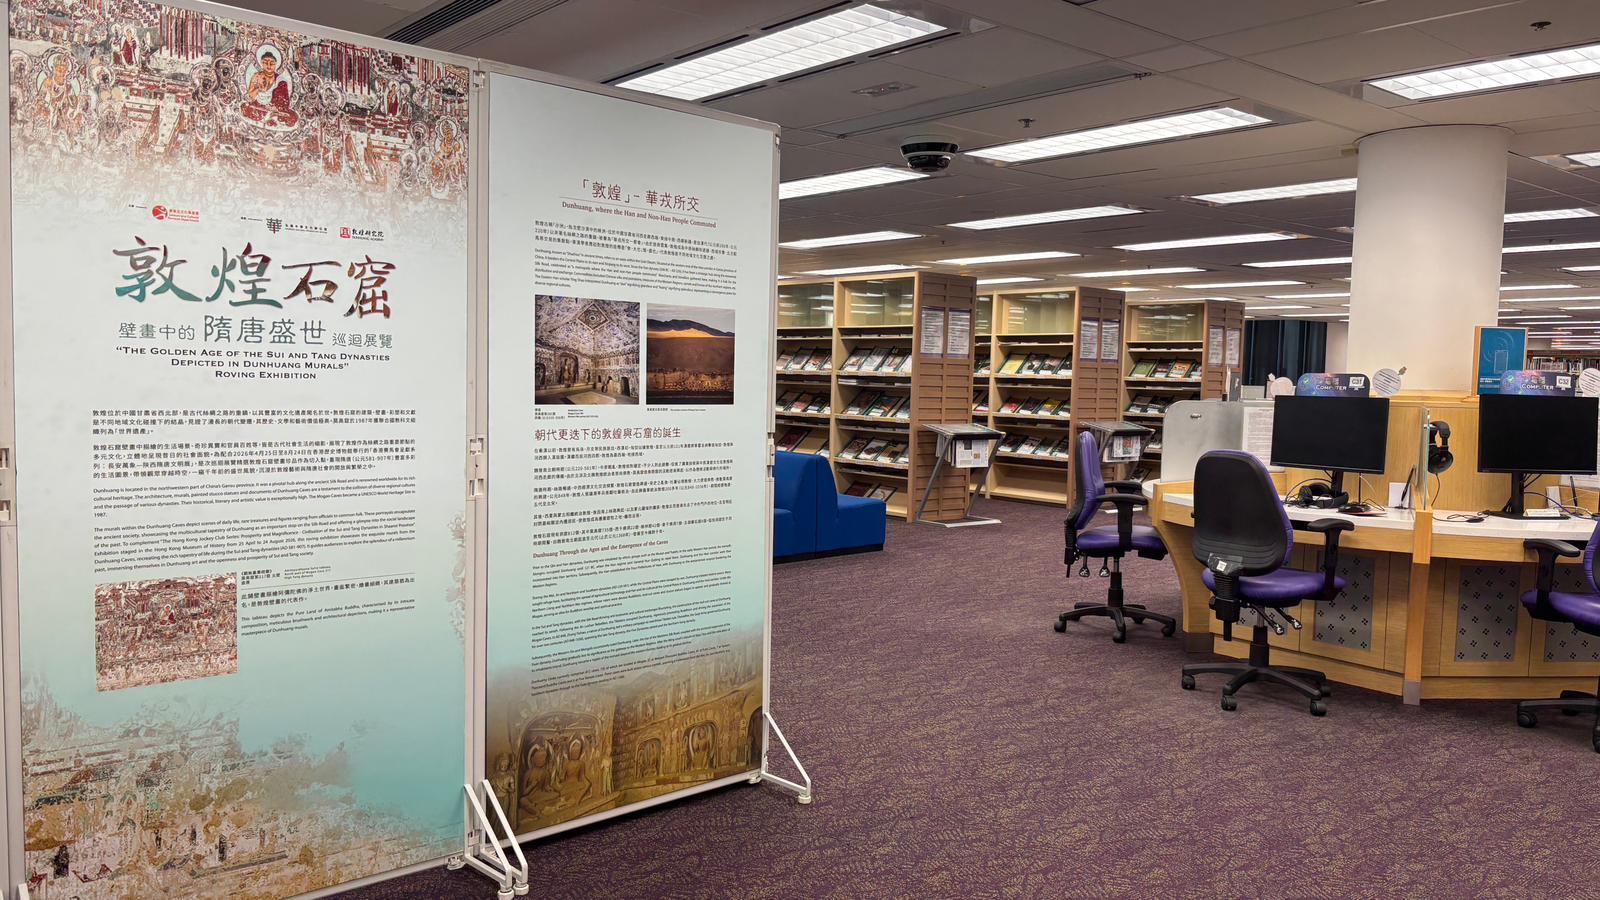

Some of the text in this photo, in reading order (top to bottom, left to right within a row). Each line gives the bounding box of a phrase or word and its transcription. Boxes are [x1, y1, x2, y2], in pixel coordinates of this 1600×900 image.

[645, 190, 700, 213] 華戎所交
[562, 201, 593, 212] Dunhuang,
[648, 213, 671, 222] Non-Han
[672, 216, 689, 226] People
[690, 219, 716, 228] Commuted
[112, 236, 396, 320] 敦煌石窟
[118, 315, 393, 350] 壁畫中的 隋唐盛世 巡迴展覽
[116, 346, 146, 355] “THE
[150, 347, 196, 356] GOLDEN
[201, 348, 222, 357] AGE
[226, 350, 240, 358] OF
[244, 350, 263, 358] THE
[266, 351, 285, 359] SUI
[312, 352, 337, 360] TANG
[340, 353, 390, 362] DYNASTIES
[171, 359, 349, 370] DEPICTED IN DUNHUANG MURALS”
[215, 370, 316, 380] ROVING EXHIBITION
[534, 426, 681, 441] 朝代更迭下的敦煌與石窟的誕生
[533, 550, 558, 559] Dunhuang
[559, 548, 580, 556] Through
[618, 542, 642, 550] Emergence
